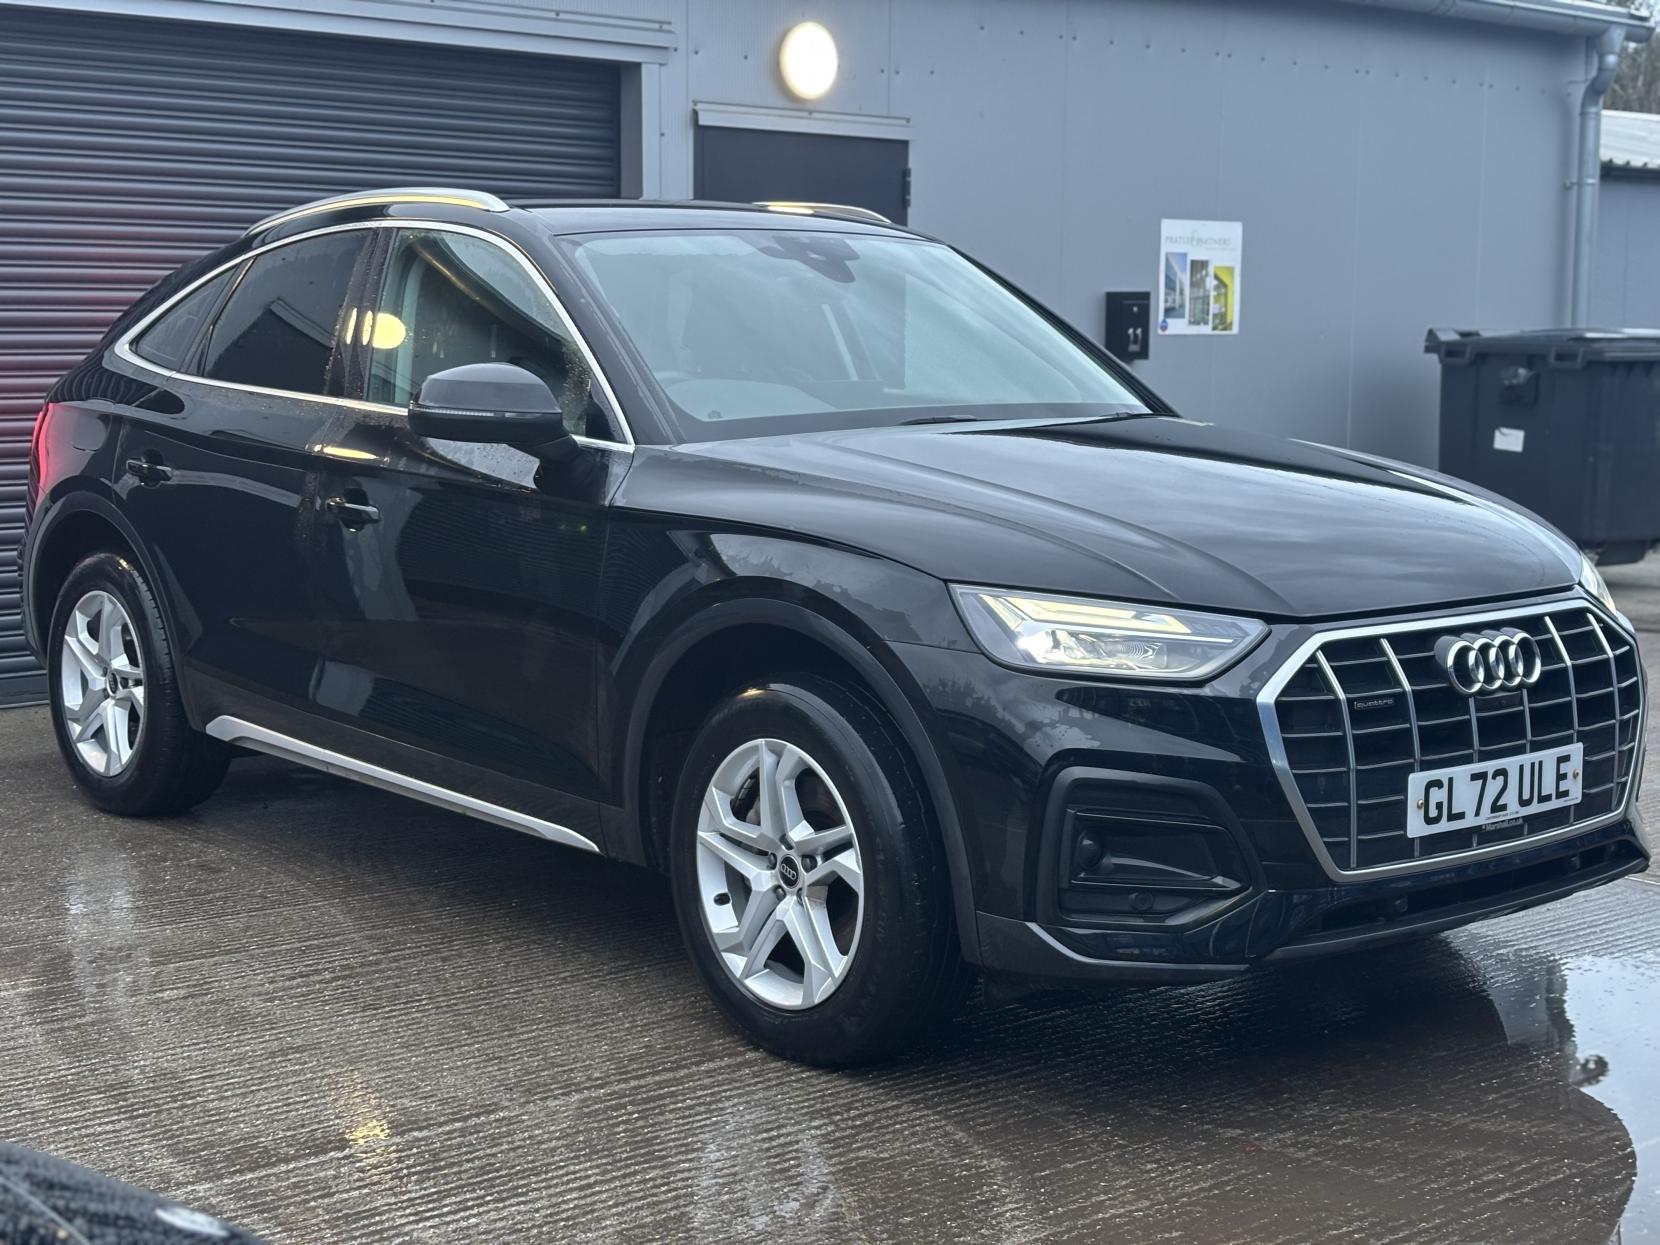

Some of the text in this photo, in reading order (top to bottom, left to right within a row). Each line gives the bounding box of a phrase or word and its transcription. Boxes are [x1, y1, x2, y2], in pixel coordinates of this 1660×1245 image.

[1127, 327, 1142, 345] 11
[1423, 754, 1571, 826] GL 72 ULE
